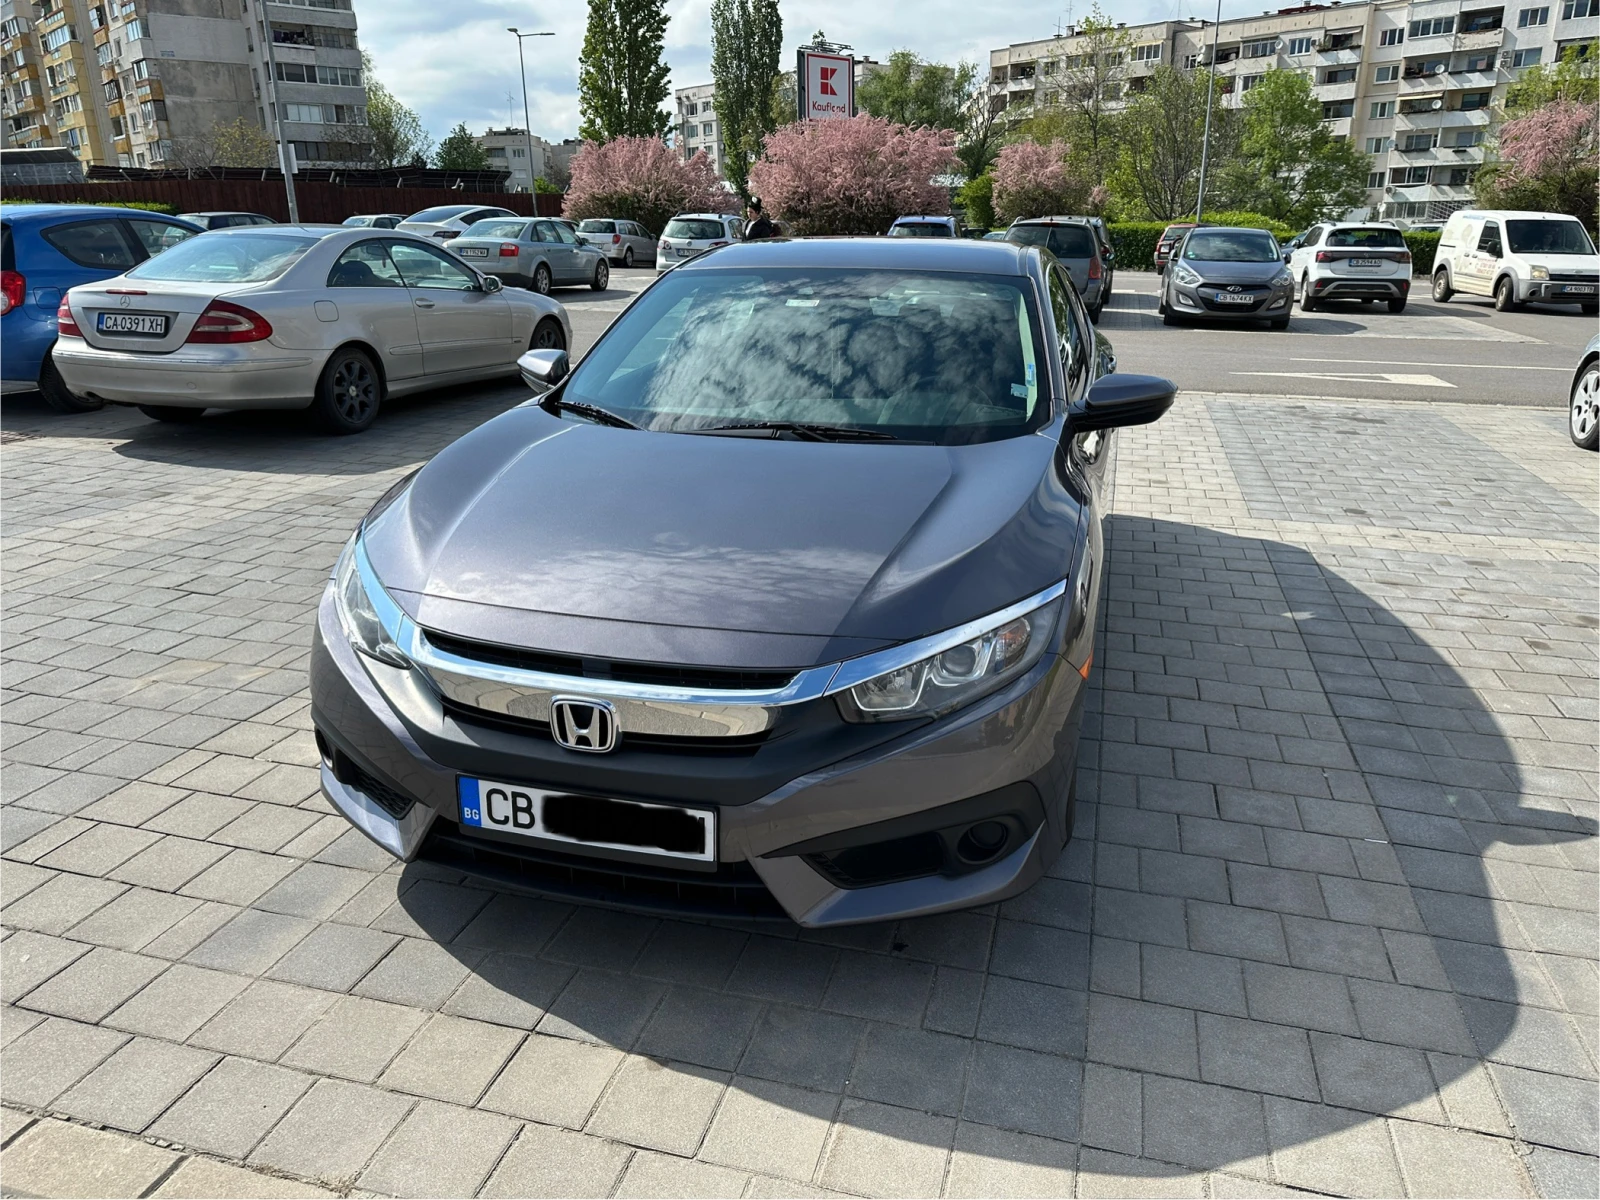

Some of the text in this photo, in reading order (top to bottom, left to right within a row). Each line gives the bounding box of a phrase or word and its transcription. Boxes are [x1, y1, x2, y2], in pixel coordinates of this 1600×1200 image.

[105, 316, 164, 332] CA 0391 XH
[464, 807, 480, 820] BG
[486, 788, 536, 830] CB
